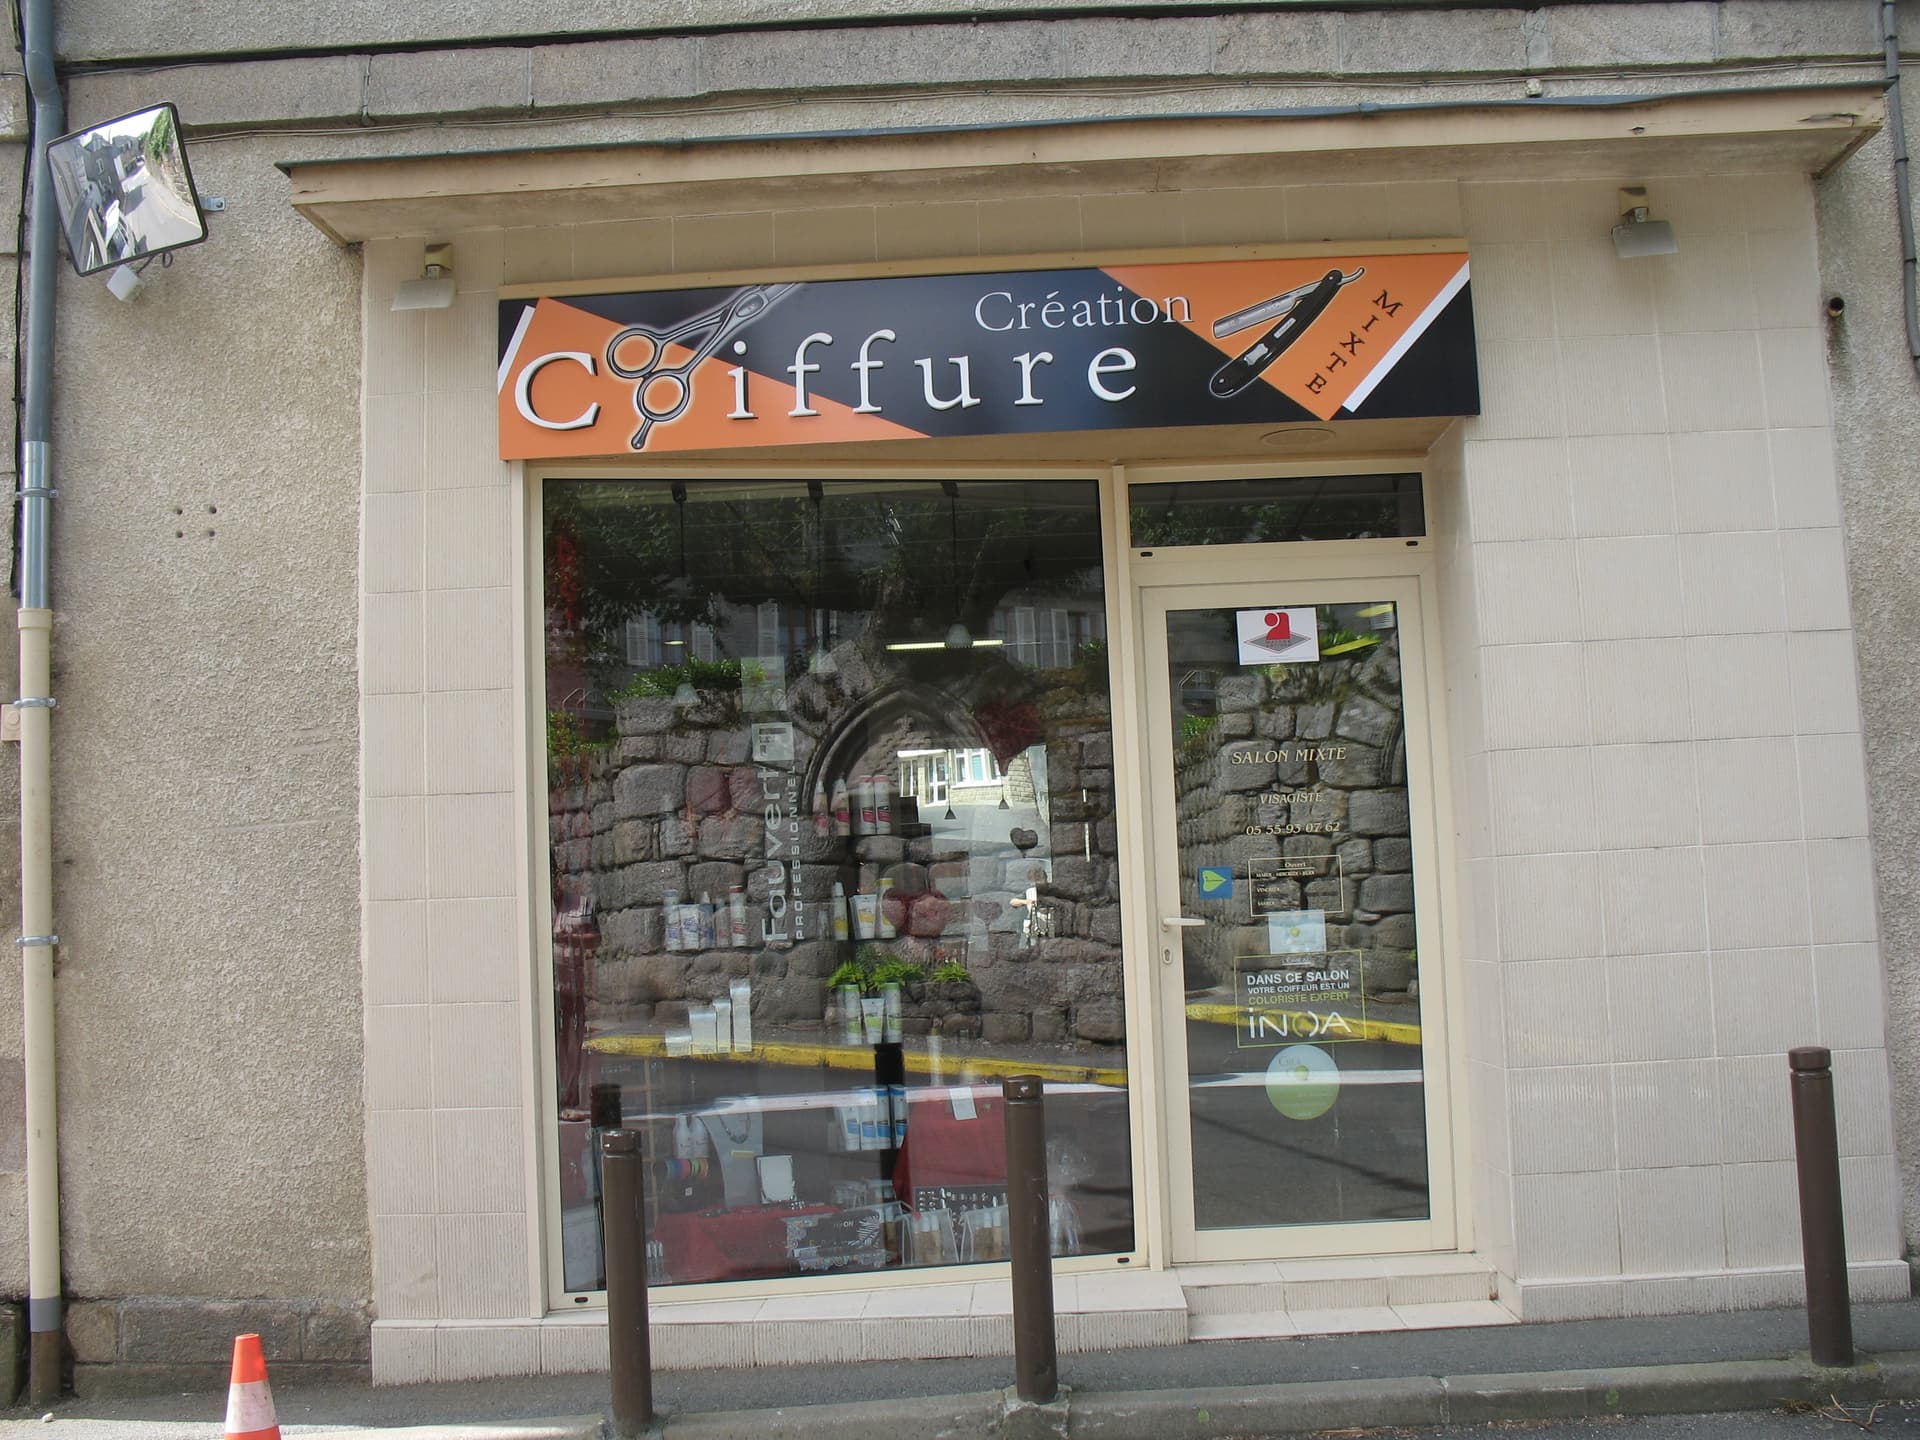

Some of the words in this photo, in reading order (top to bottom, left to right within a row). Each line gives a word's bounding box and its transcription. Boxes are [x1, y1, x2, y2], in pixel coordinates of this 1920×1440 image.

[974, 288, 1193, 332] Création
[1306, 288, 1403, 395] MIXTE
[1231, 750, 1289, 764] SALON
[1295, 747, 1347, 761] MIXTE
[1260, 792, 1323, 804] VISAGISTE
[1246, 825, 1262, 835] 05
[1266, 824, 1281, 835] 55
[1325, 822, 1340, 832] 62
[757, 766, 788, 941] Fauvert
[787, 765, 804, 940] PROFESSIONNEL
[1247, 973, 1282, 985] DANS
[1286, 972, 1303, 983] CE
[1306, 969, 1349, 982] SALON
[1248, 986, 1275, 994] VOTRE
[1277, 984, 1318, 993] COIFFEUR
[1320, 982, 1335, 990] EST
[1338, 981, 1349, 989] UN
[1249, 994, 1307, 1005] COLORISTE
[1310, 991, 1349, 1000] EXPERT
